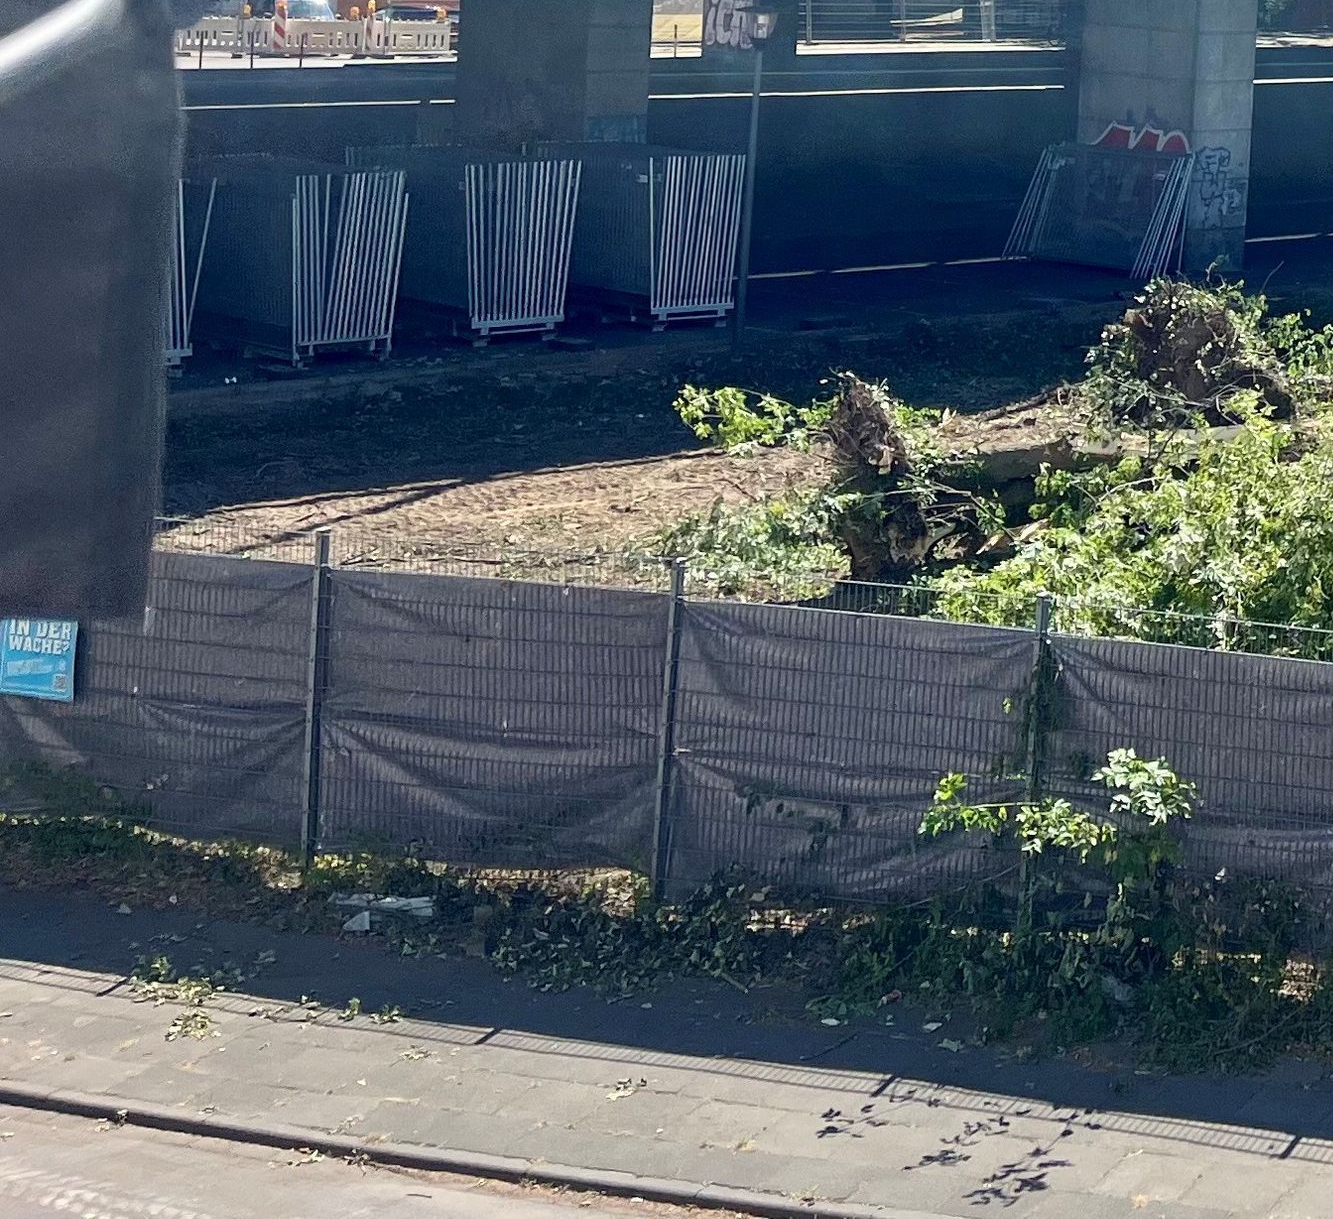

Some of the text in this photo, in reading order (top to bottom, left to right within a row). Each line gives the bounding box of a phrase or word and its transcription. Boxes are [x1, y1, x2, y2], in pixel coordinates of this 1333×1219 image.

[9, 619, 72, 640] IN DER
[9, 634, 70, 655] WACHE?
